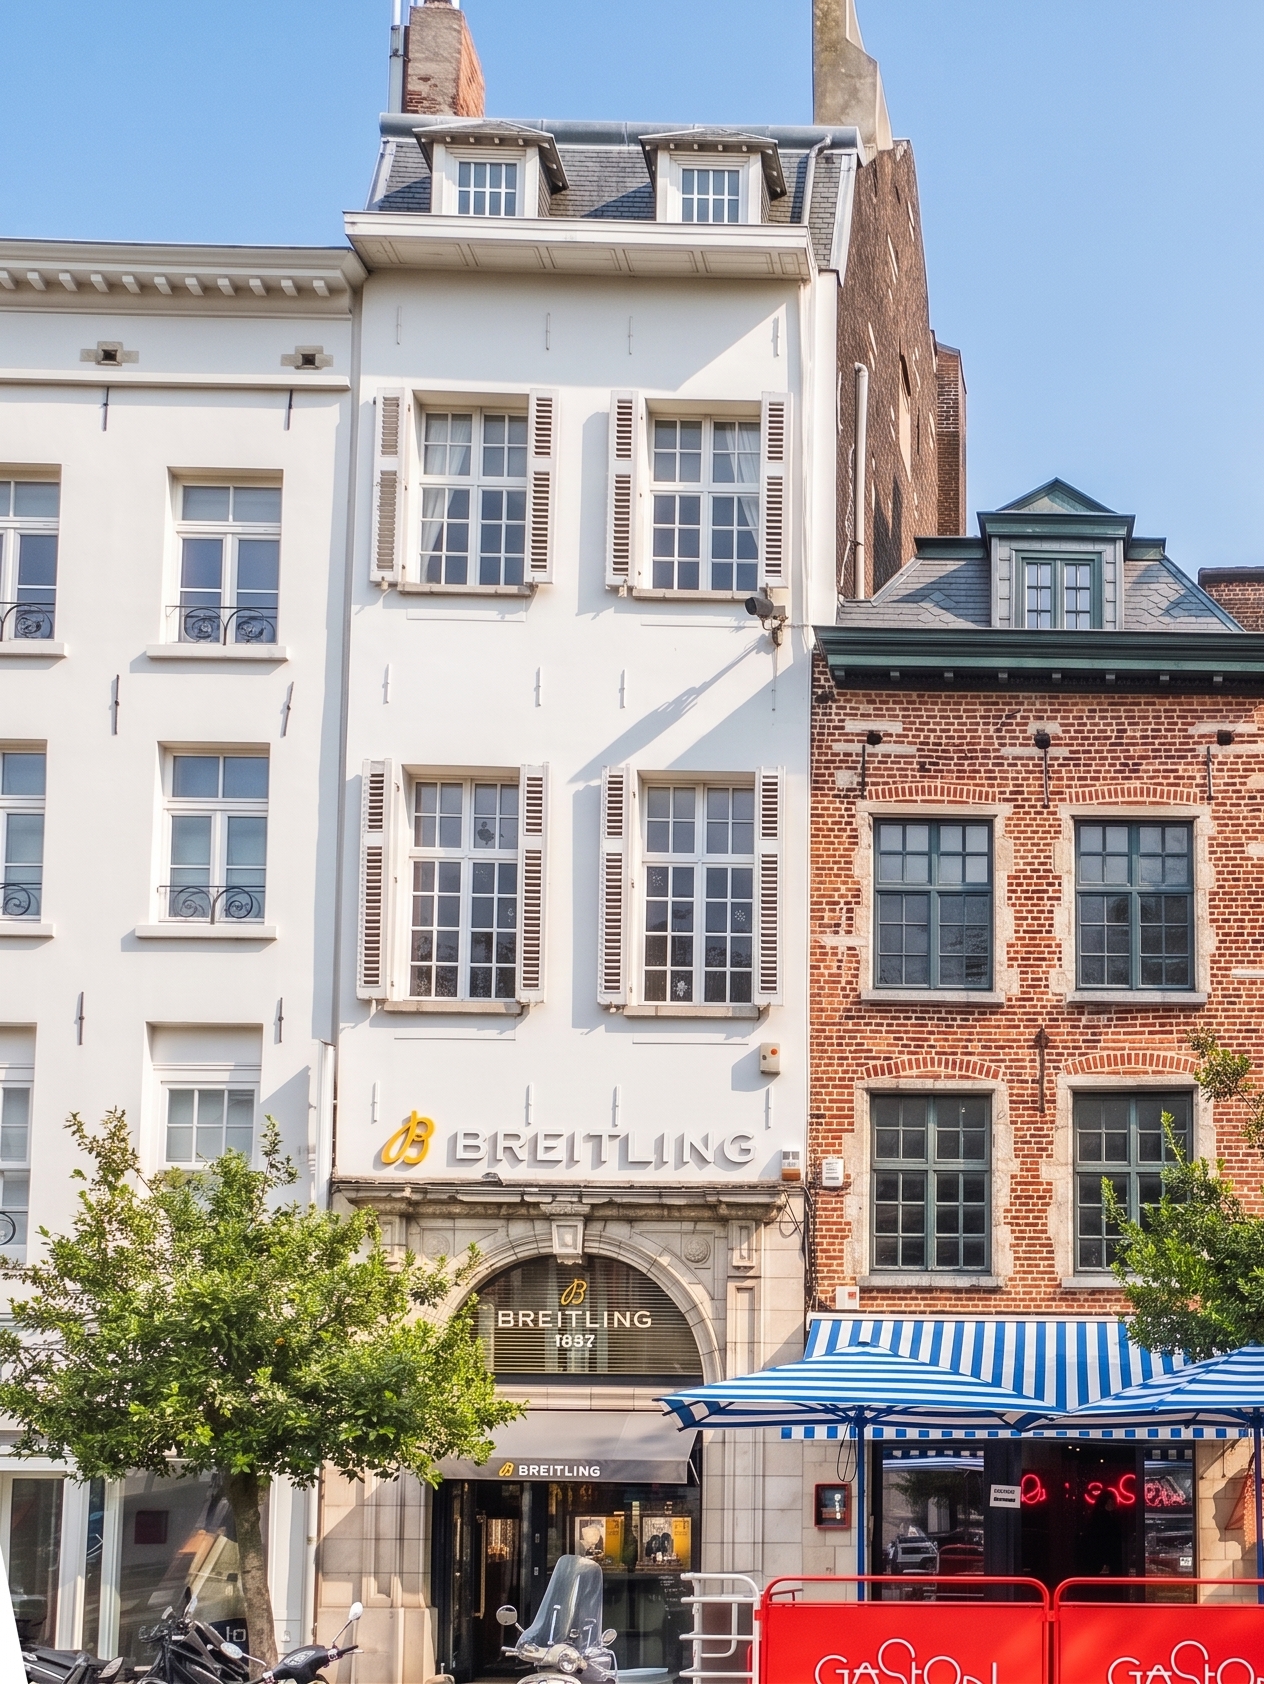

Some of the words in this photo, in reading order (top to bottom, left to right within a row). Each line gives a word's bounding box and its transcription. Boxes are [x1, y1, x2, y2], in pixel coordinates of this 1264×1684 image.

[455, 1127, 757, 1164] BREITLING
[497, 1310, 652, 1328] BREITLING
[518, 1465, 601, 1477] BREITLING
